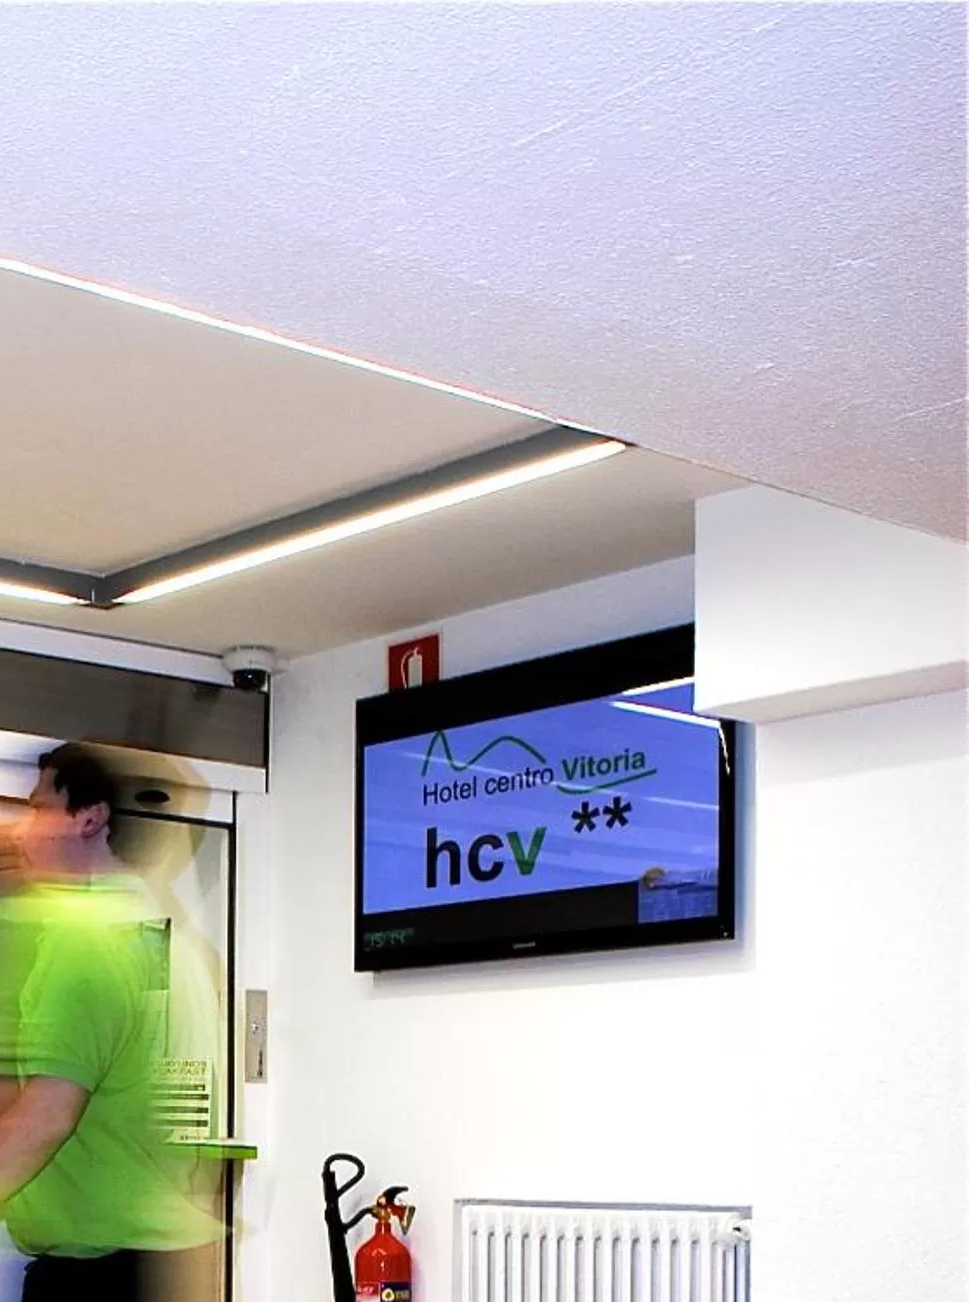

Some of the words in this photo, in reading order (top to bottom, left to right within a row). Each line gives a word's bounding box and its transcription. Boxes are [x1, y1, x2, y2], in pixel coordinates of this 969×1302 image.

[423, 776, 477, 806] Hotel
[484, 766, 554, 796] centro
[562, 748, 646, 780] Vitoria
[426, 826, 547, 888] hcv
